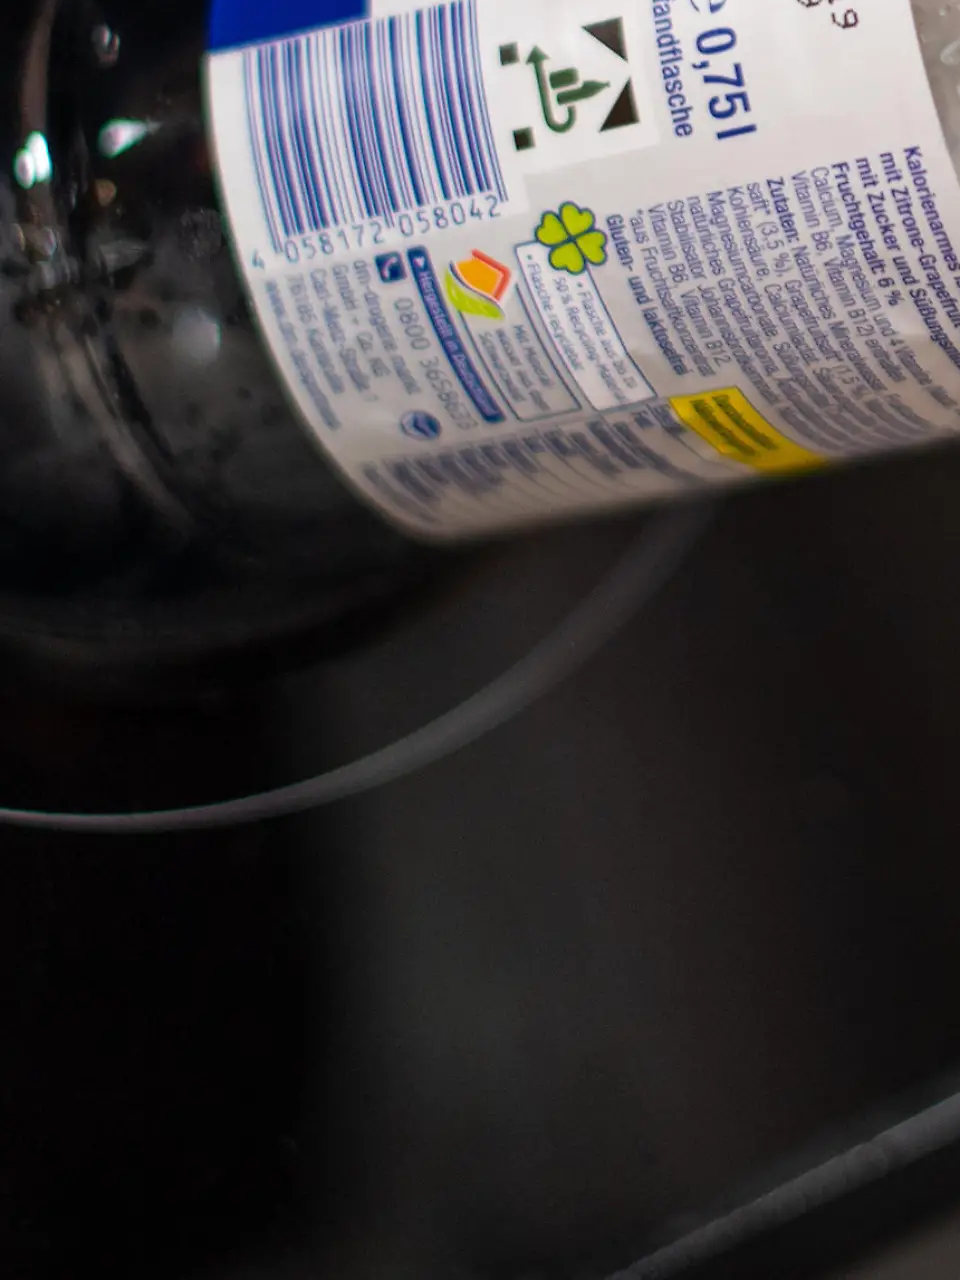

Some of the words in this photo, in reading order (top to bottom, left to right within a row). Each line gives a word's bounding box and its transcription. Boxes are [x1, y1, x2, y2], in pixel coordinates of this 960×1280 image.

[691, 27, 752, 120] 0,75
[879, 152, 901, 183] mit
[251, 250, 265, 269] 4
[282, 219, 385, 264] 058172
[397, 193, 501, 238] 058042
[666, 199, 708, 280] Stabilisator
[687, 196, 726, 276] natürliches
[726, 186, 770, 281] Kohlensäure,
[766, 177, 800, 243] Zutaten:
[791, 245, 837, 321] Natürliches
[790, 170, 821, 228] Vitamin
[823, 257, 856, 307] Vitamin
[810, 166, 844, 230] Calcium,
[835, 234, 882, 312] Magnesium
[872, 314, 897, 337] und
[831, 161, 886, 274] Fruchtgehalt:
[877, 276, 894, 288] 6
[886, 290, 903, 307] %
[855, 157, 877, 189] mit
[866, 191, 901, 250] Zucker
[892, 255, 919, 286] und
[419, 270, 457, 337] Hergestellt
[605, 214, 634, 272] Gluten-
[627, 275, 654, 306] und
[641, 306, 694, 377] laktosefrei
[647, 204, 677, 261] Vitamin
[679, 290, 713, 338] Vitamin
[394, 298, 431, 350] 0800
